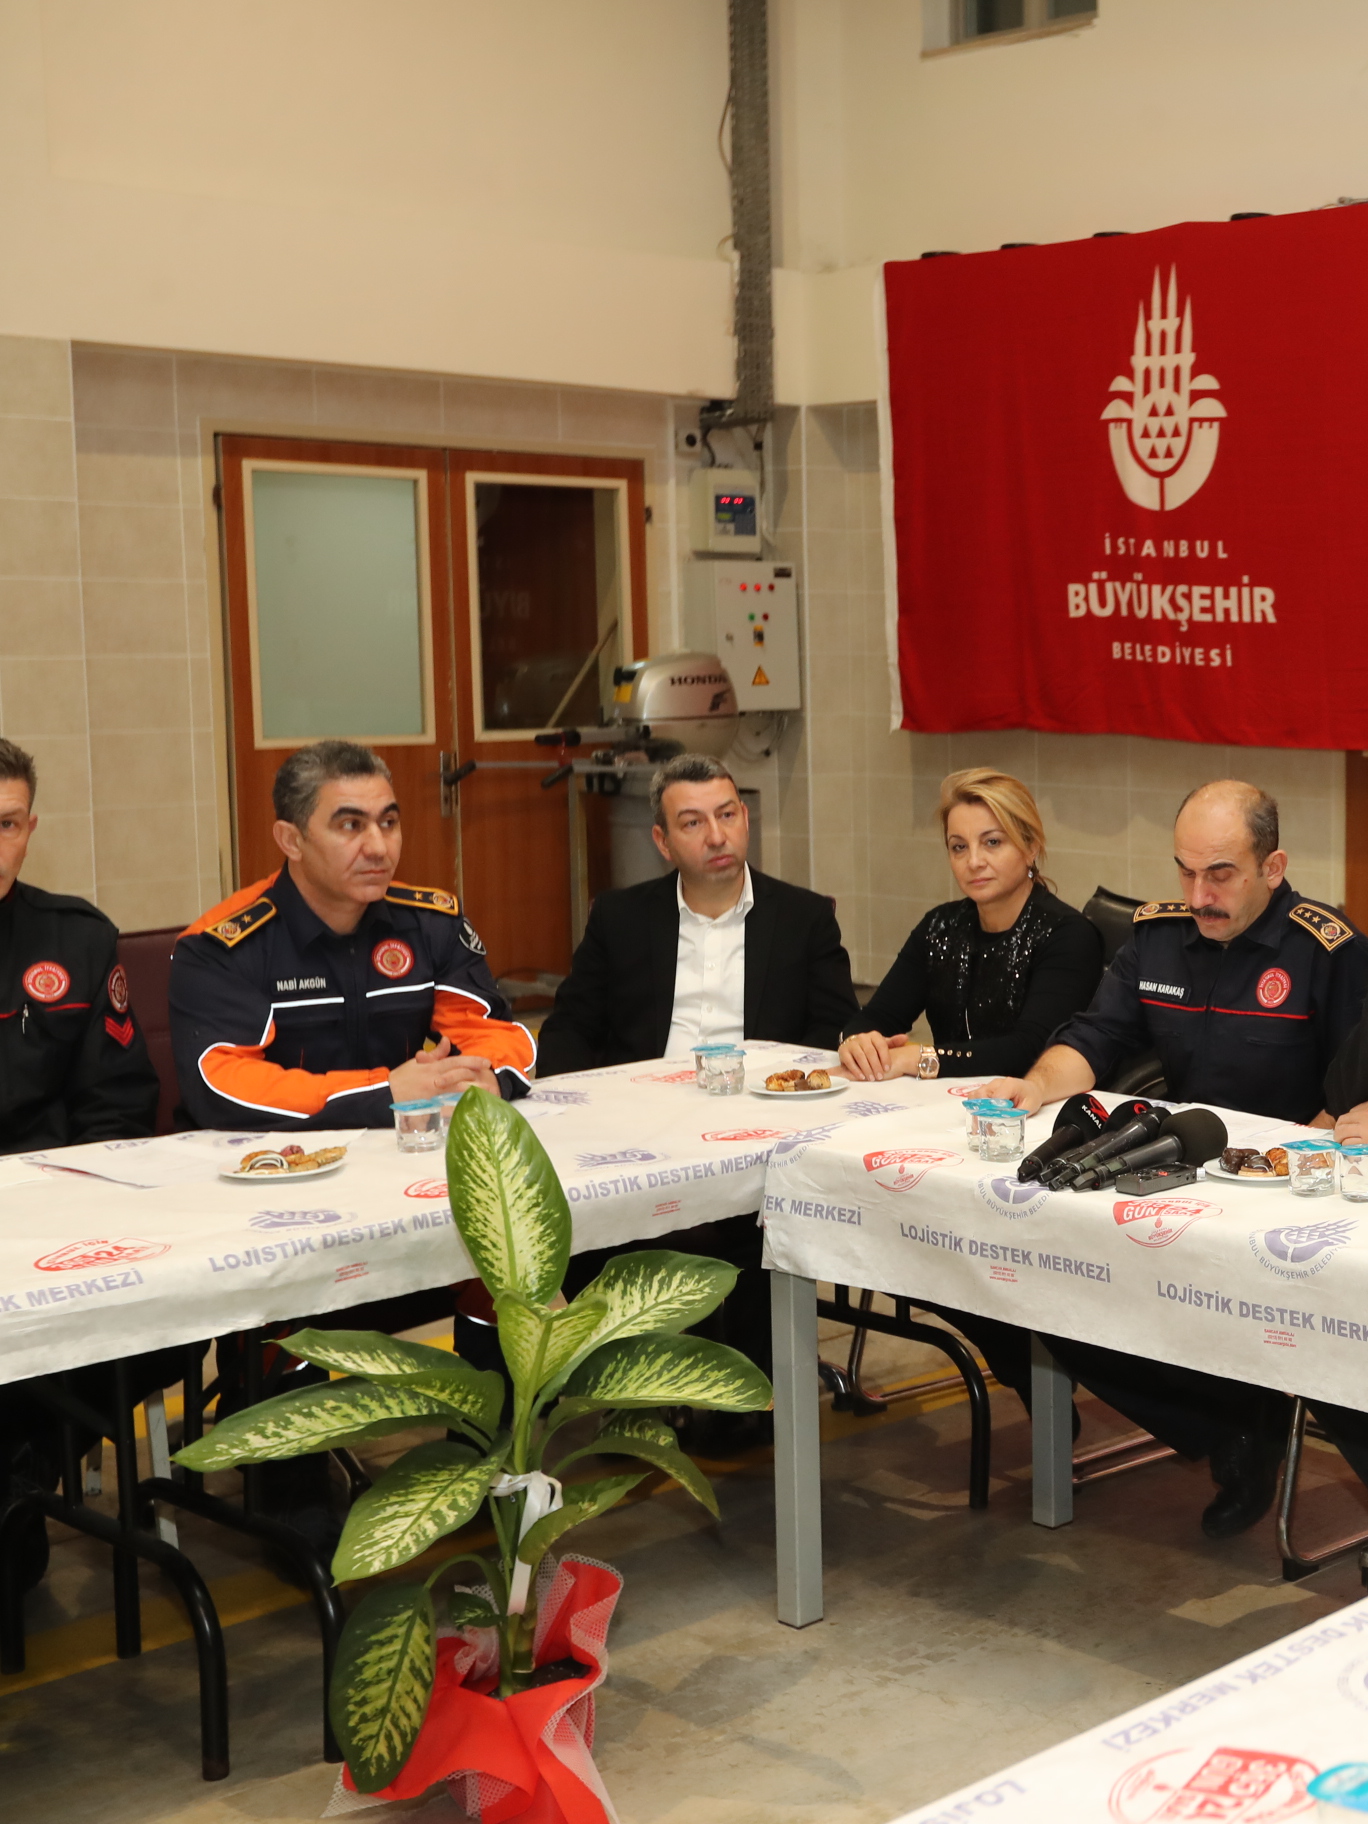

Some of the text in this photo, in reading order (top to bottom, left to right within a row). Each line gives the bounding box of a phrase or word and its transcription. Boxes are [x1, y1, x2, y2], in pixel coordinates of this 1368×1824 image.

[1104, 532, 1228, 559] İSTANBUL
[1067, 571, 1277, 632] BÜYÜKŞEHİR
[1112, 640, 1233, 668] BELEDİYESİ
[670, 674, 728, 687] HONDA
[276, 976, 326, 991] NABİ AKGÜN
[1139, 980, 1185, 999] HASAN KARAKAŞ
[1081, 1104, 1103, 1130] KANAL
[567, 1173, 641, 1203] OJİSTİK
[647, 1161, 715, 1189] DESTEK
[789, 1198, 862, 1226] MERKEZİ
[986, 1198, 1029, 1220] BÜYÜKŞEHİR
[209, 1238, 317, 1272] LOJİSTİK
[323, 1217, 409, 1250] DESTEK
[901, 1222, 964, 1254] LOJİSTİK
[968, 1239, 1033, 1267] DESTEK
[1038, 1253, 1111, 1283] MERKEZİ
[1259, 1255, 1310, 1280] BÜYÜKŞEHİR
[25, 1267, 144, 1306] MERKEZİ
[1157, 1280, 1234, 1314] LOJİSTİK
[1239, 1300, 1316, 1331] DESTEK
[1235, 1622, 1345, 1685] DESTEK
[1100, 1679, 1241, 1753] MERKEZİ
